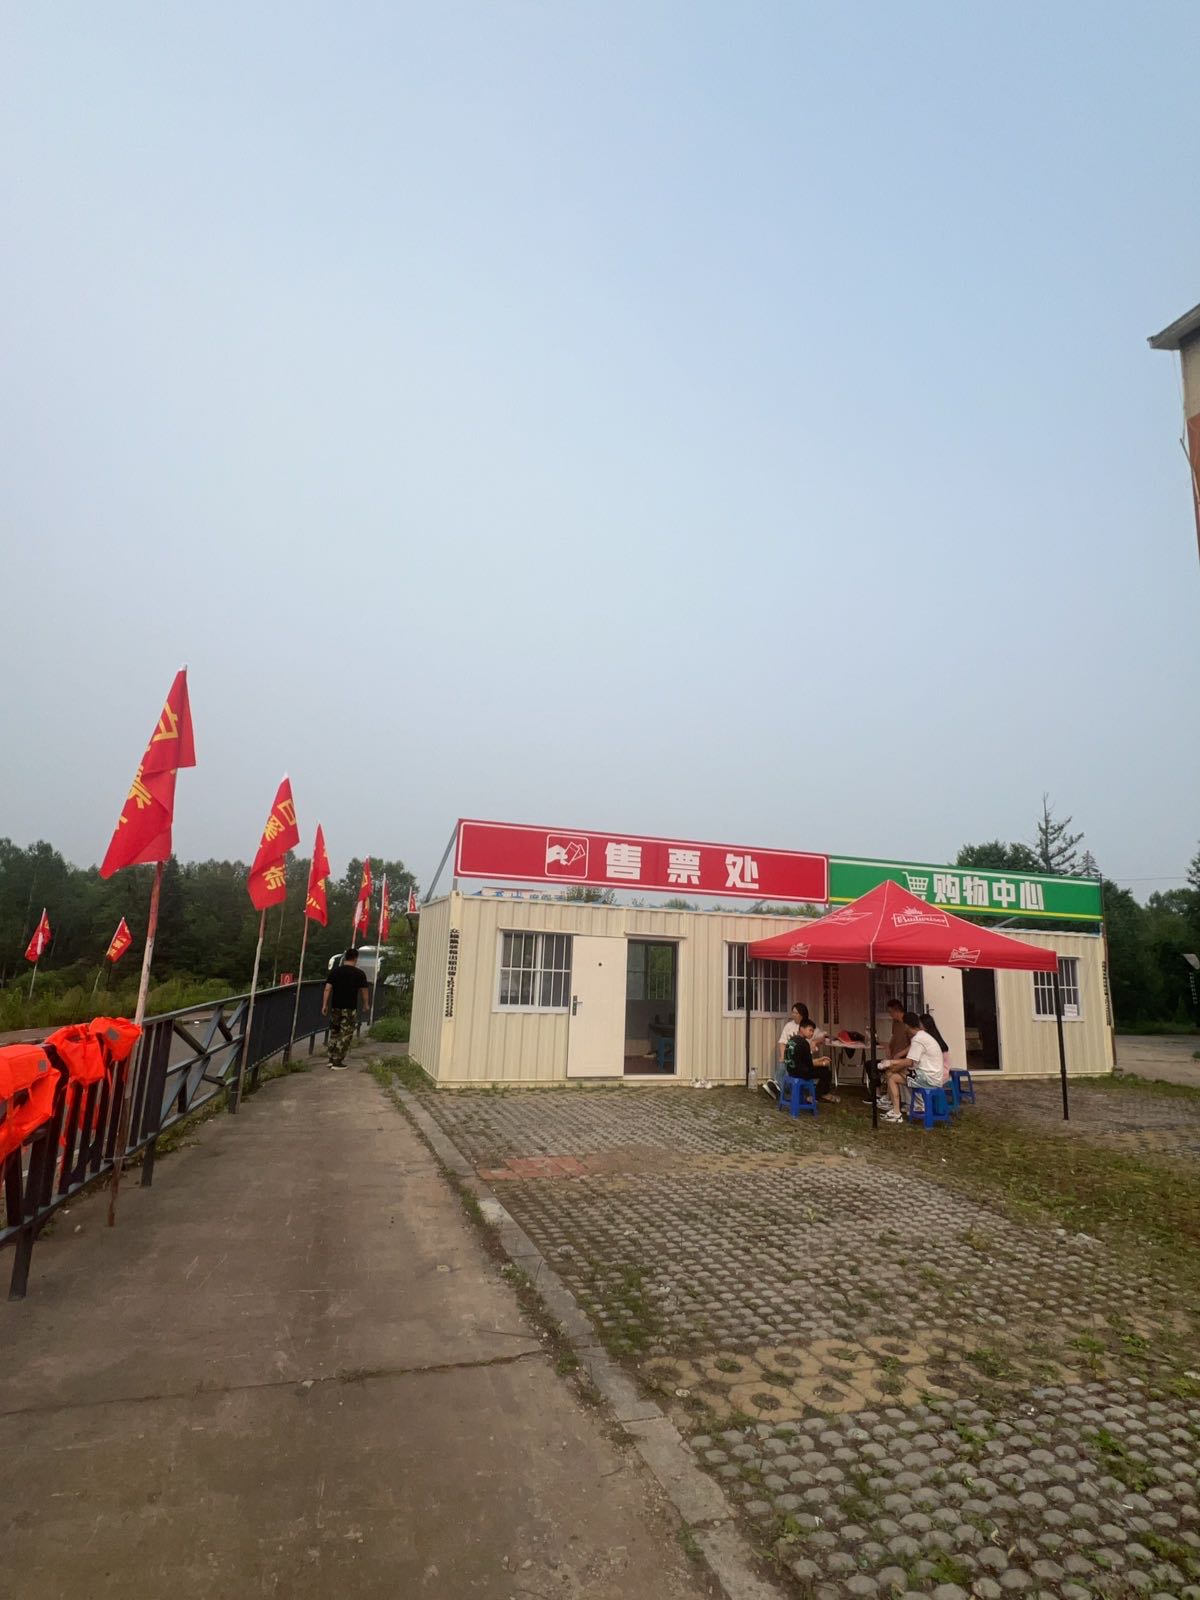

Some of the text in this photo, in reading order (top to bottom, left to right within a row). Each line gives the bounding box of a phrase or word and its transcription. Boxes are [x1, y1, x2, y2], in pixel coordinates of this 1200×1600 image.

[605, 842, 759, 889] 售票处
[933, 874, 1045, 910] 购物中心
